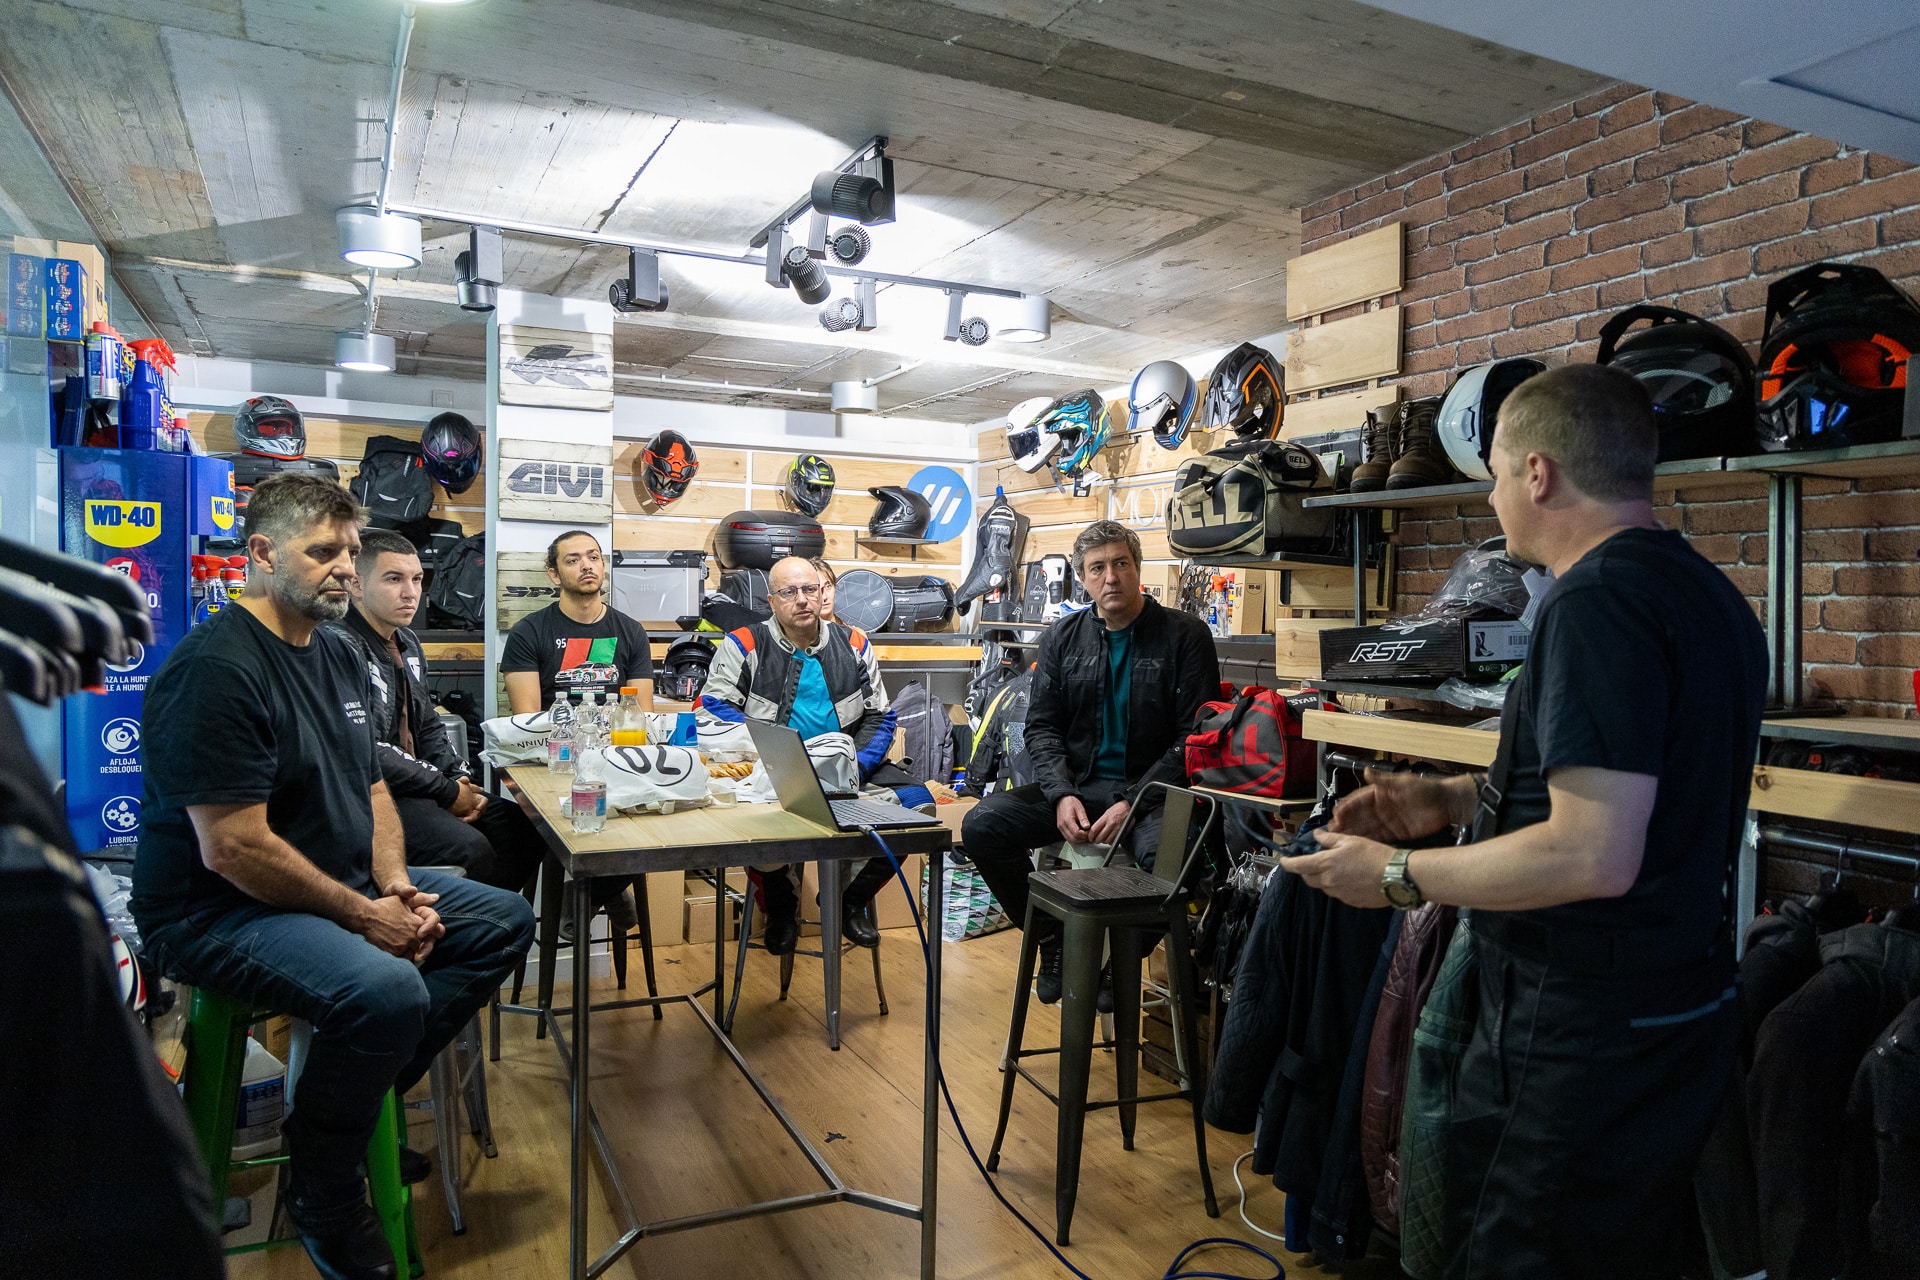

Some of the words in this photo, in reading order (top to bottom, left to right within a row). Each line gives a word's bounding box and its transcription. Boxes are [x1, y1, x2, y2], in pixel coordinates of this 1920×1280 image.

[1288, 455, 1308, 465] BELL
[506, 462, 604, 498] GIVI
[213, 500, 233, 516] WD-40
[90, 504, 156, 528] WD-40
[555, 638, 567, 649] 95
[1348, 639, 1427, 663] RST
[130, 675, 151, 683] HUME
[109, 758, 137, 766] AFLOJA
[108, 836, 139, 845] LUBRICA
